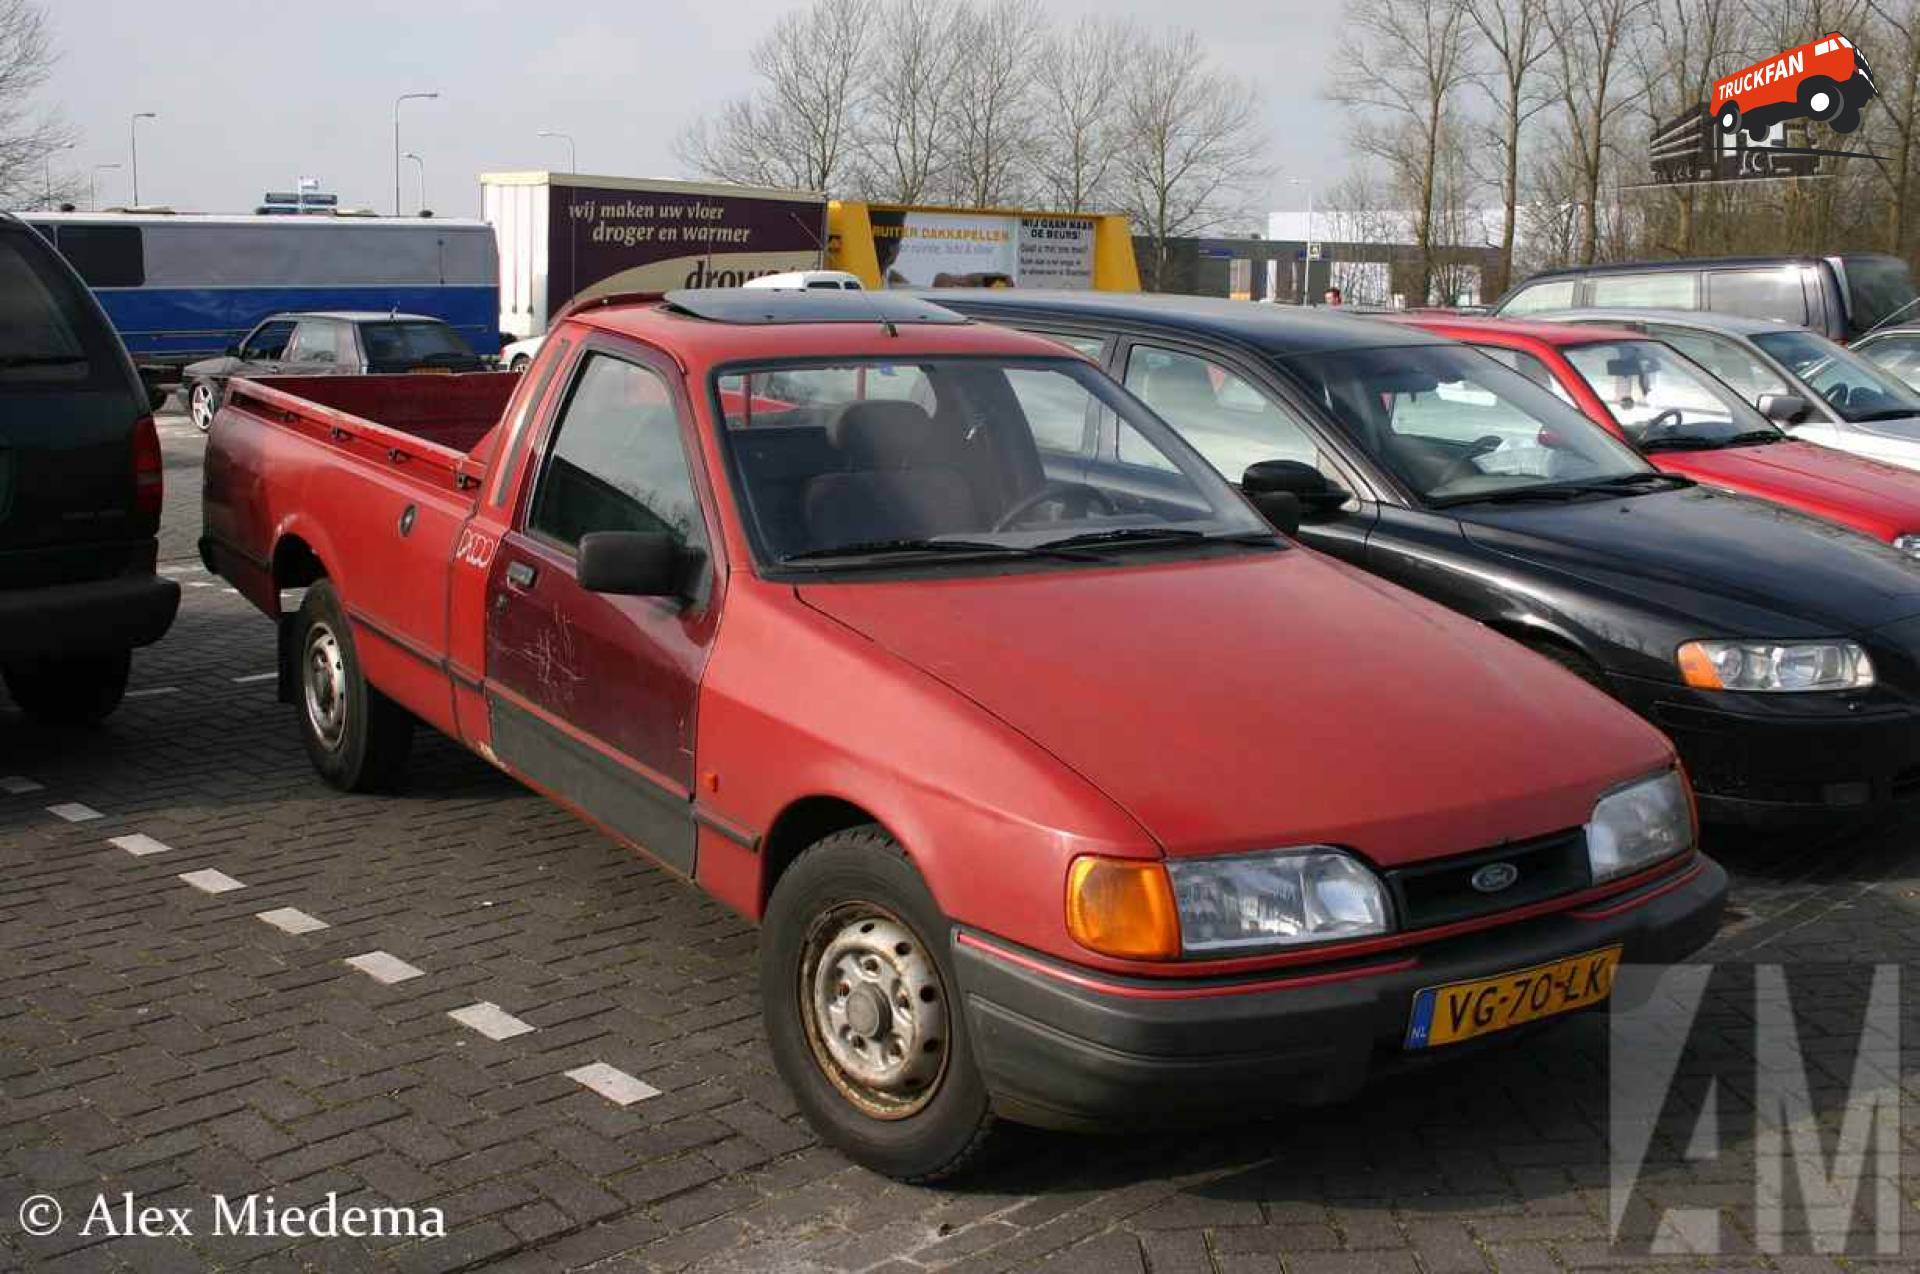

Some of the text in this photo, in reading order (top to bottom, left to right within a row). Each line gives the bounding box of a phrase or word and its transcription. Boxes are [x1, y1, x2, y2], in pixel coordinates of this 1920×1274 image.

[569, 201, 725, 221] wij maken uw vloer
[592, 221, 750, 245] droger en warmer
[1448, 957, 1607, 1033] VG-70-LK
[1410, 1026, 1427, 1040] NL
